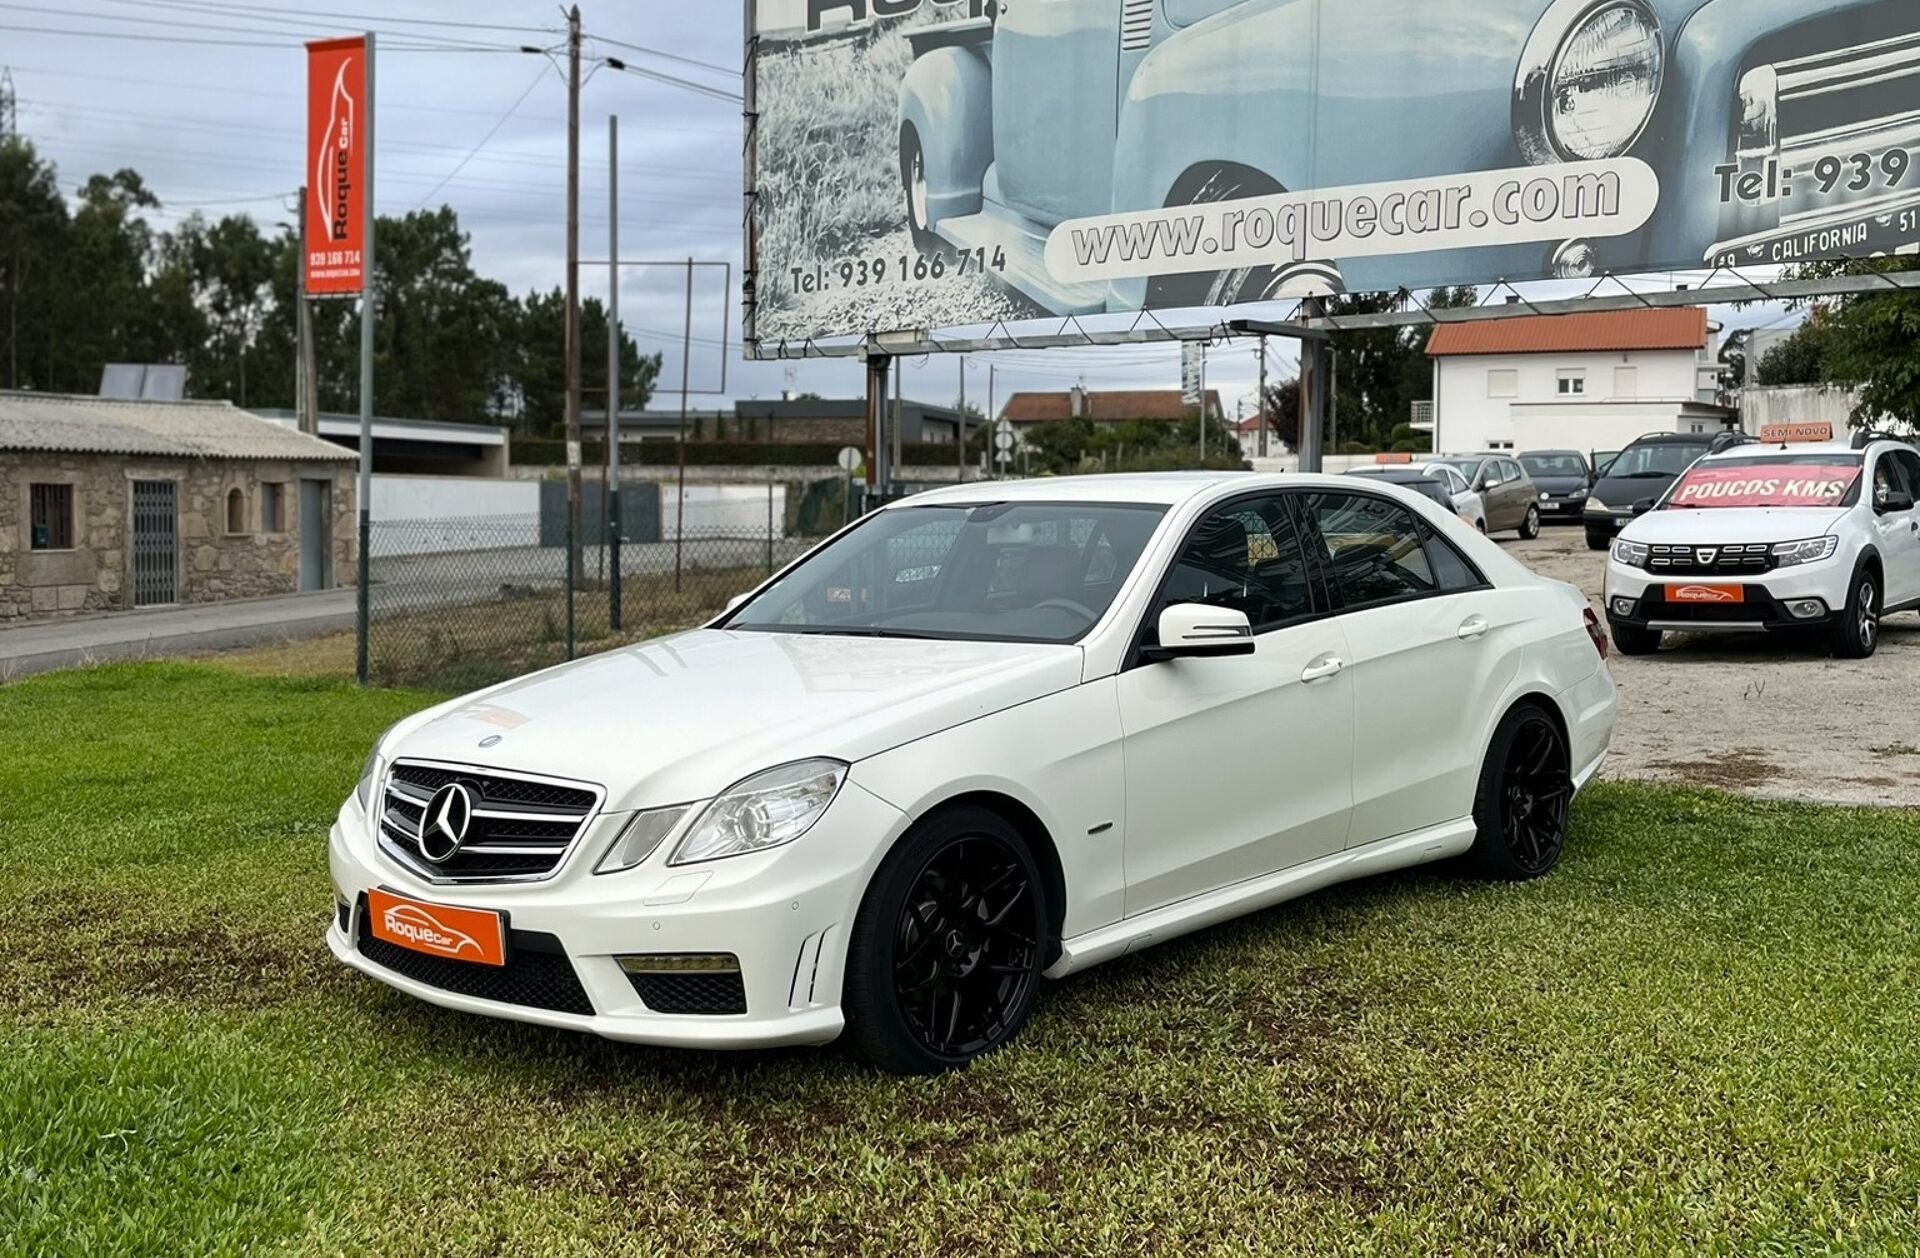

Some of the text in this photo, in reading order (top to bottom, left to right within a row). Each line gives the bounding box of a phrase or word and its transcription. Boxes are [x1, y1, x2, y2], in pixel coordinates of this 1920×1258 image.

[1714, 148, 1910, 203] Tel: 939
[1071, 169, 1622, 261] www.roquecar.com
[1771, 222, 1868, 261] CALIFORNIA
[1899, 209, 1916, 232] 51
[310, 252, 326, 266] 939
[344, 250, 360, 264] 714
[791, 245, 1006, 294] Tel: 939 166 714
[1763, 427, 1828, 437] SEMI NOVO
[1679, 479, 1846, 502] POUCOS KMS
